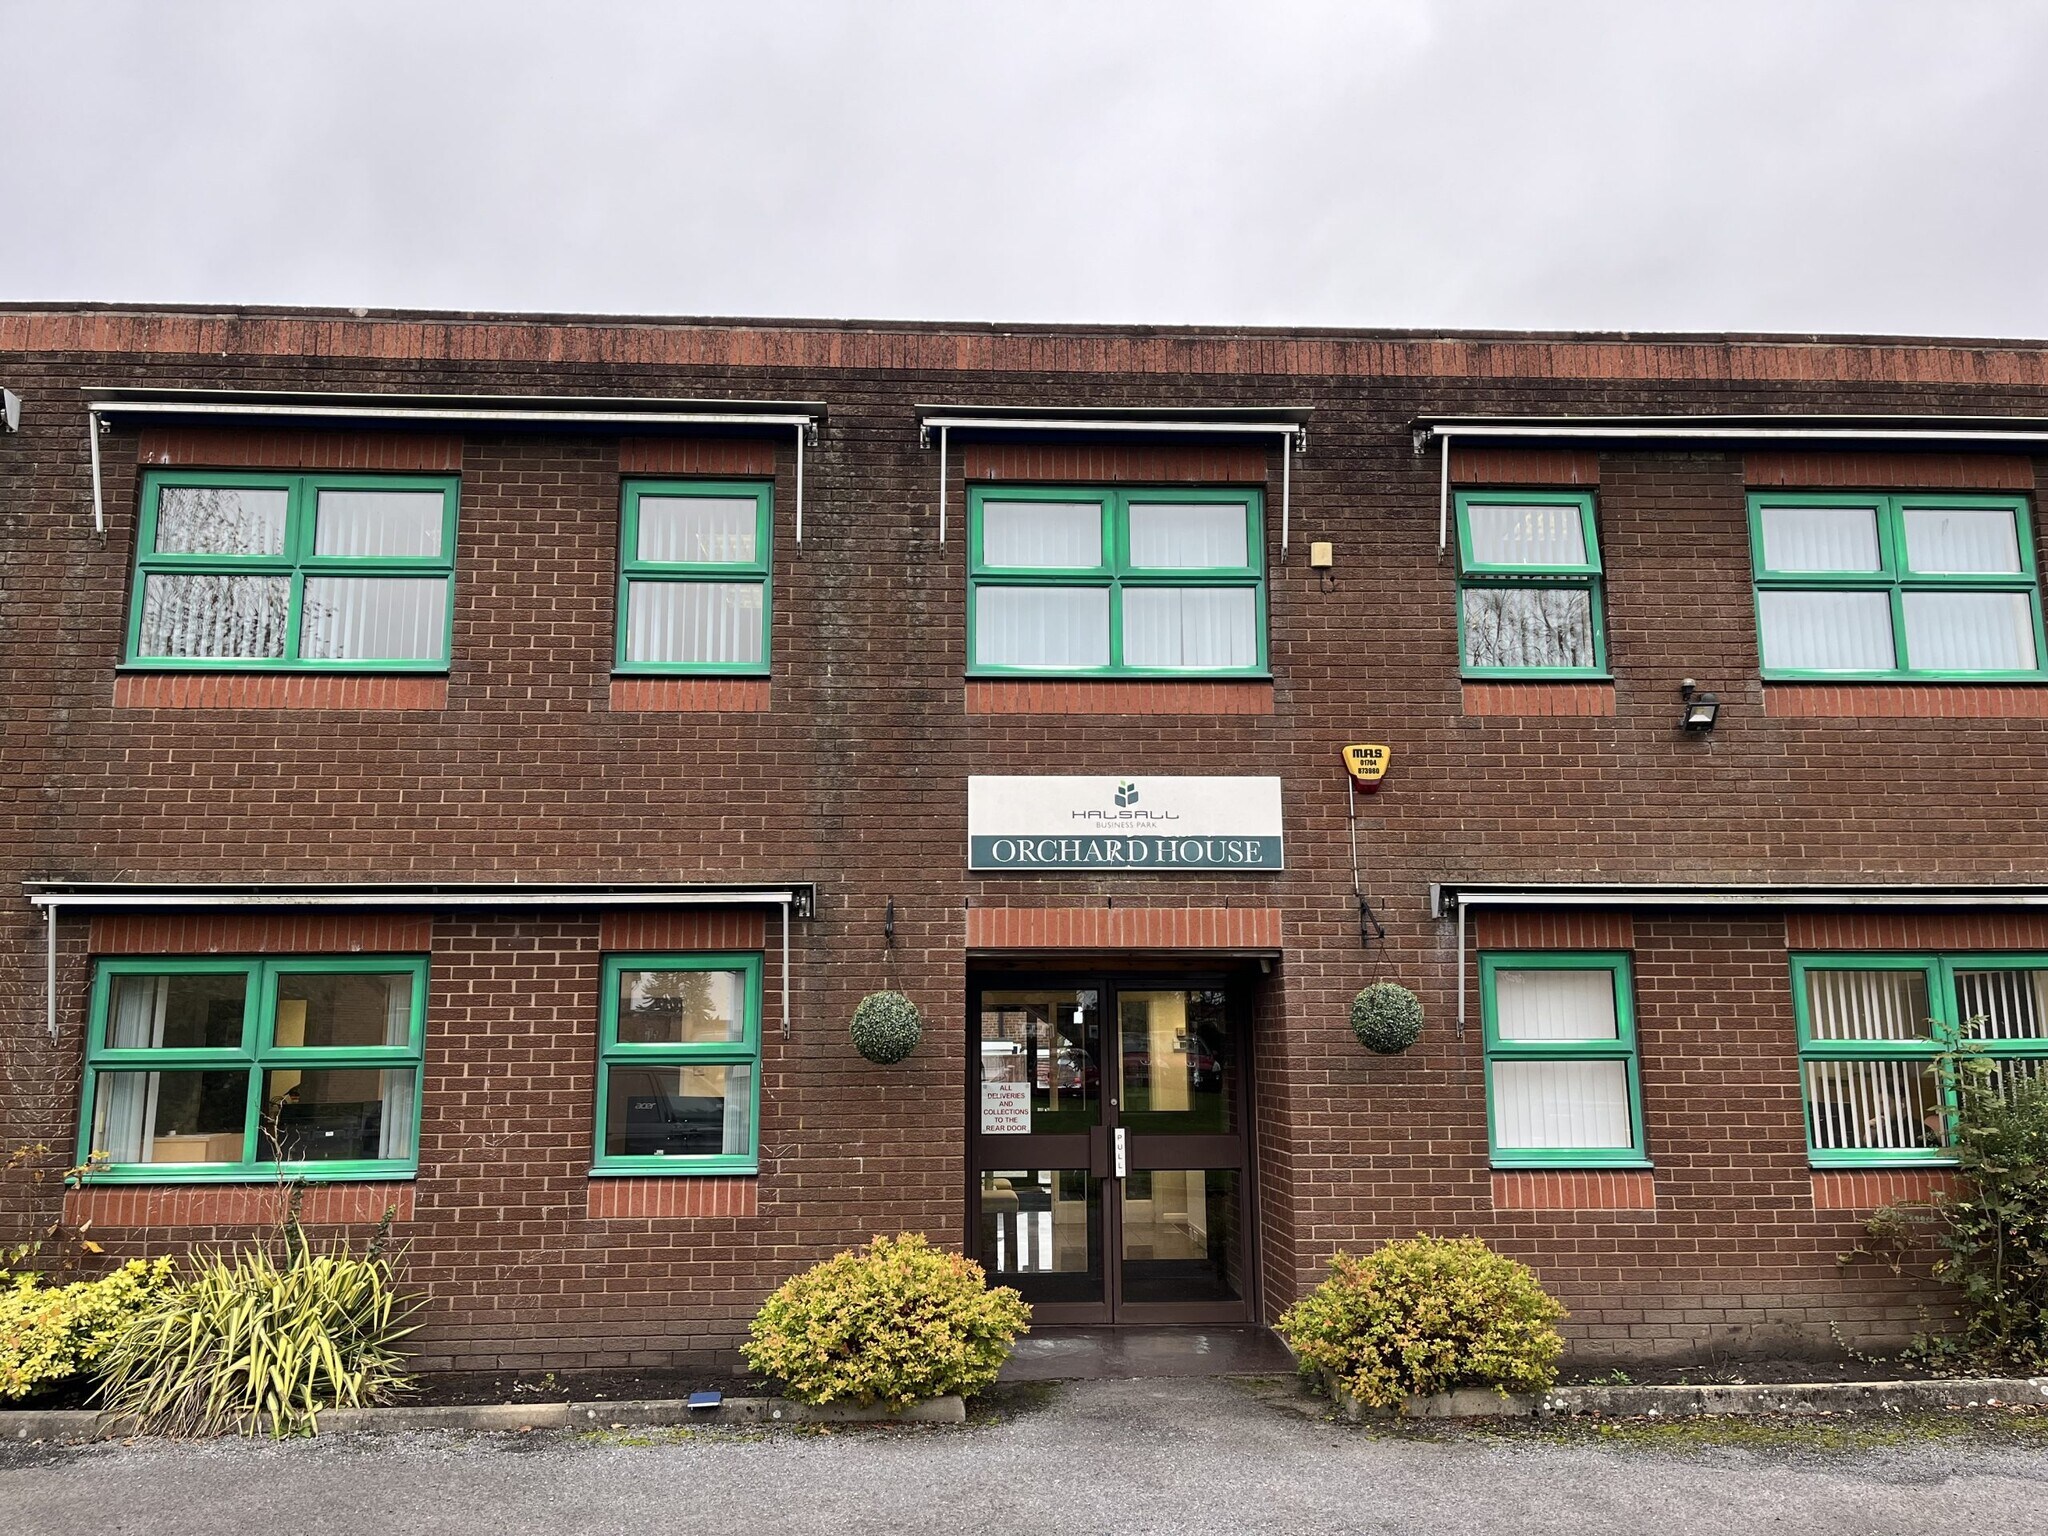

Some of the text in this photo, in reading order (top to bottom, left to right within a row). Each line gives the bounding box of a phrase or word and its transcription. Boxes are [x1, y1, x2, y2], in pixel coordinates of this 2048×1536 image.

[1071, 810, 1179, 820] HALSALL
[992, 838, 1263, 863] ORCHARD HOUSE
[634, 1102, 657, 1110] acer
